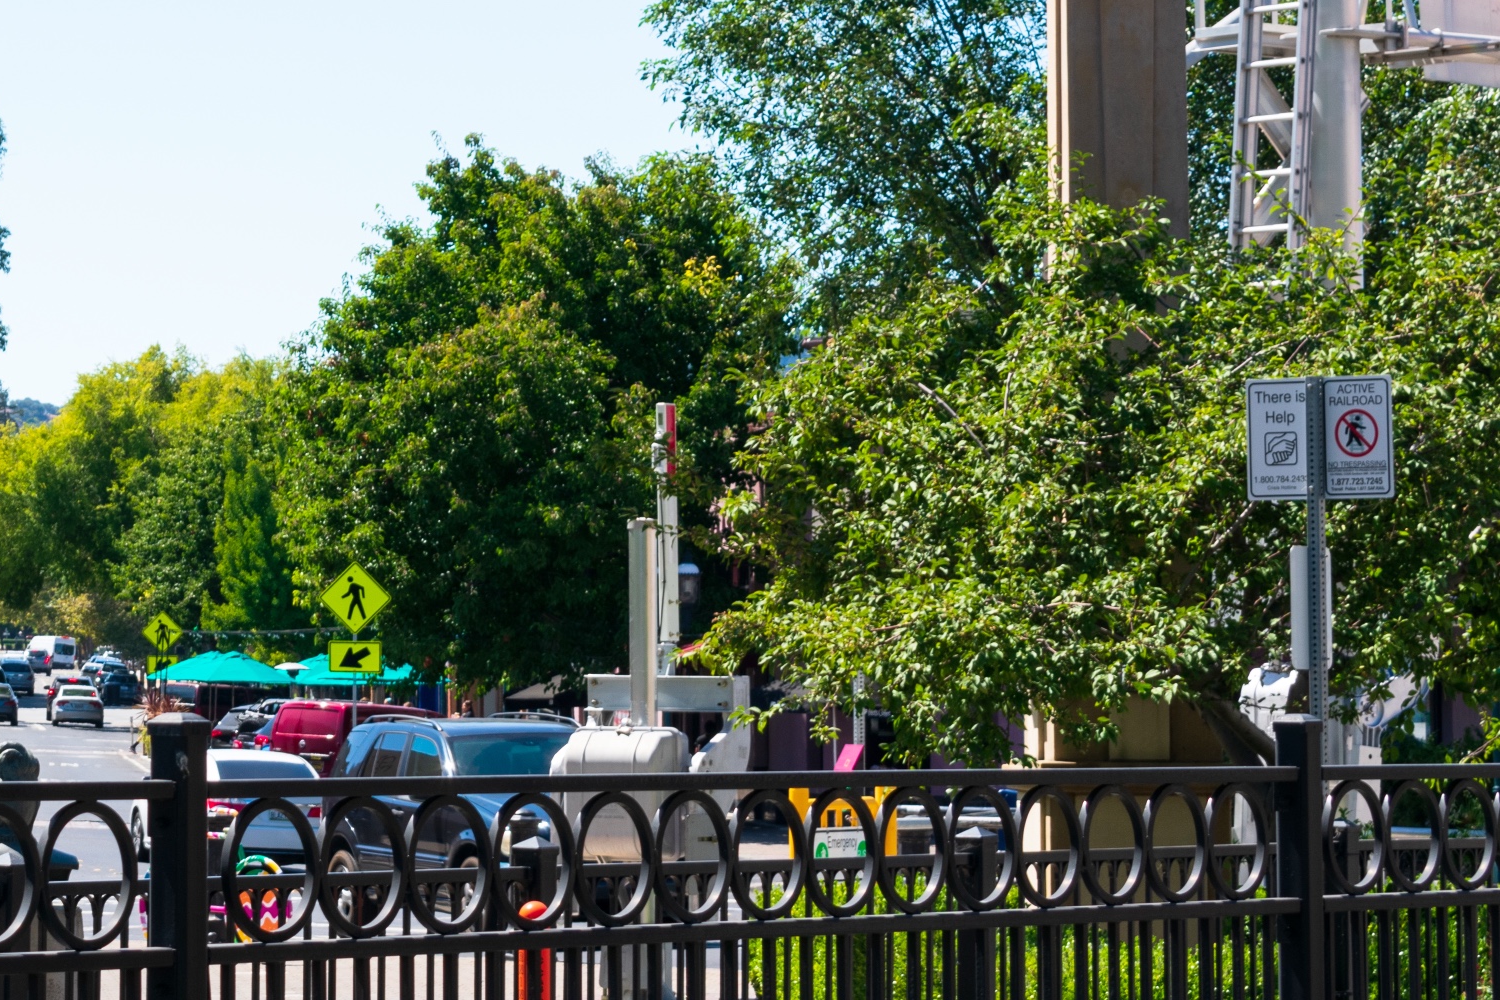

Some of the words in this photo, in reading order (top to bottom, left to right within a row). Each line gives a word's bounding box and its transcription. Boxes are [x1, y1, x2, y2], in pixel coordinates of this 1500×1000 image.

[1336, 383, 1375, 394] ACTIVE
[1254, 391, 1292, 404] There
[1295, 390, 1306, 402] is
[1329, 395, 1383, 406] RAILROAD
[1265, 411, 1296, 426] Help
[1341, 460, 1387, 468] TRESPASSING
[1331, 477, 1383, 486] 1.877.723.7245
[827, 836, 858, 852] Emergency
